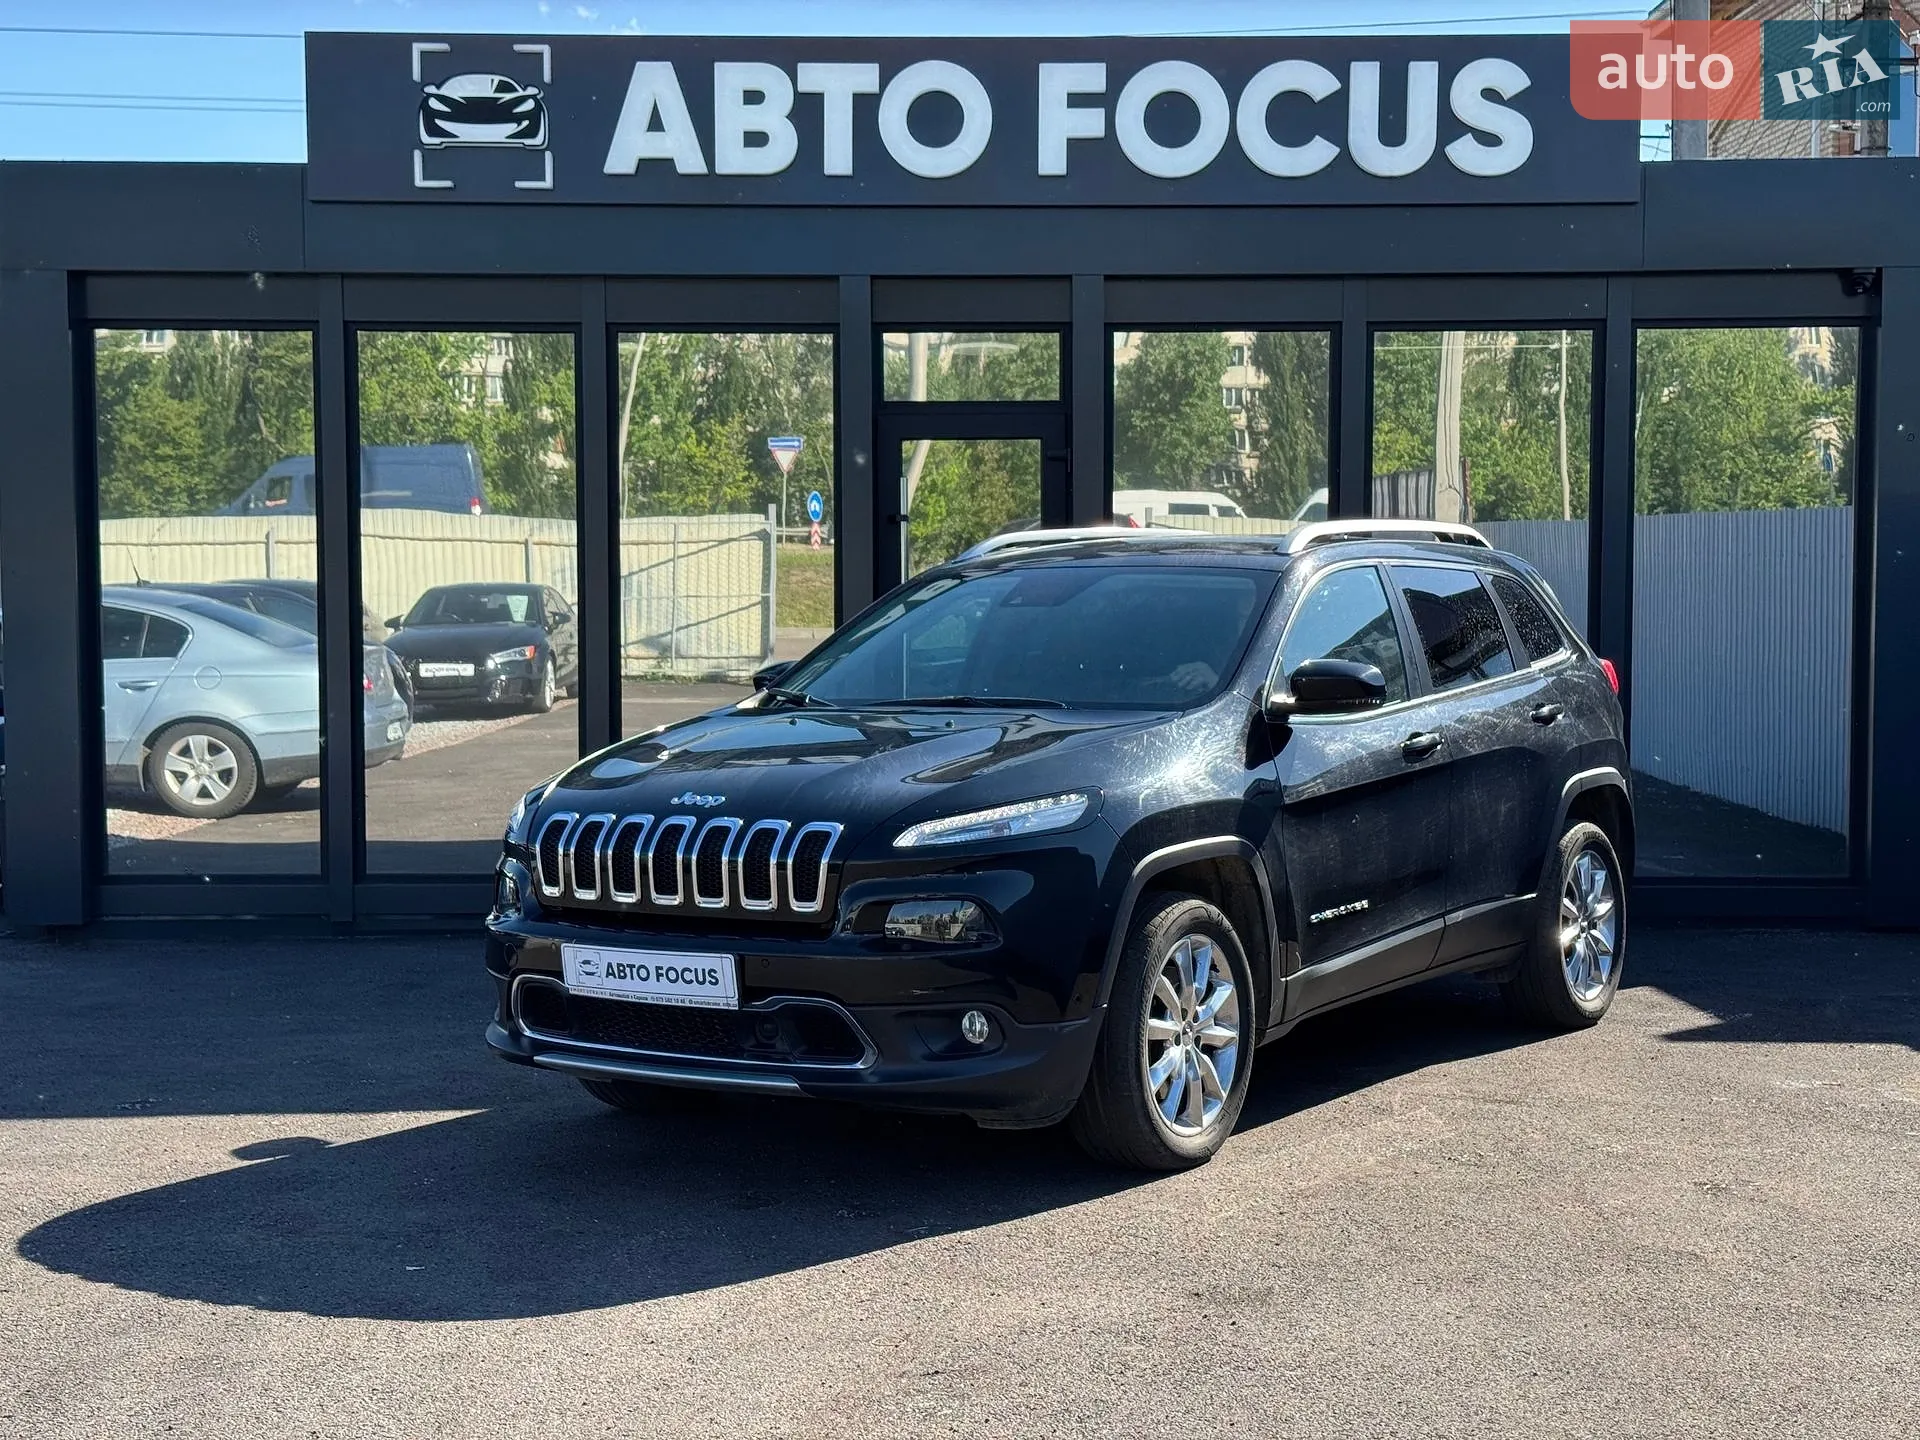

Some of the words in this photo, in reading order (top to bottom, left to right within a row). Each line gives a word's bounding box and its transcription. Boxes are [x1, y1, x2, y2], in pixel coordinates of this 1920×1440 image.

[603, 60, 993, 179] АВТО
[1037, 58, 1535, 179] FOCUS
[670, 791, 726, 808] Jeep
[605, 961, 650, 982] АВТО
[655, 965, 720, 986] FOCUS
